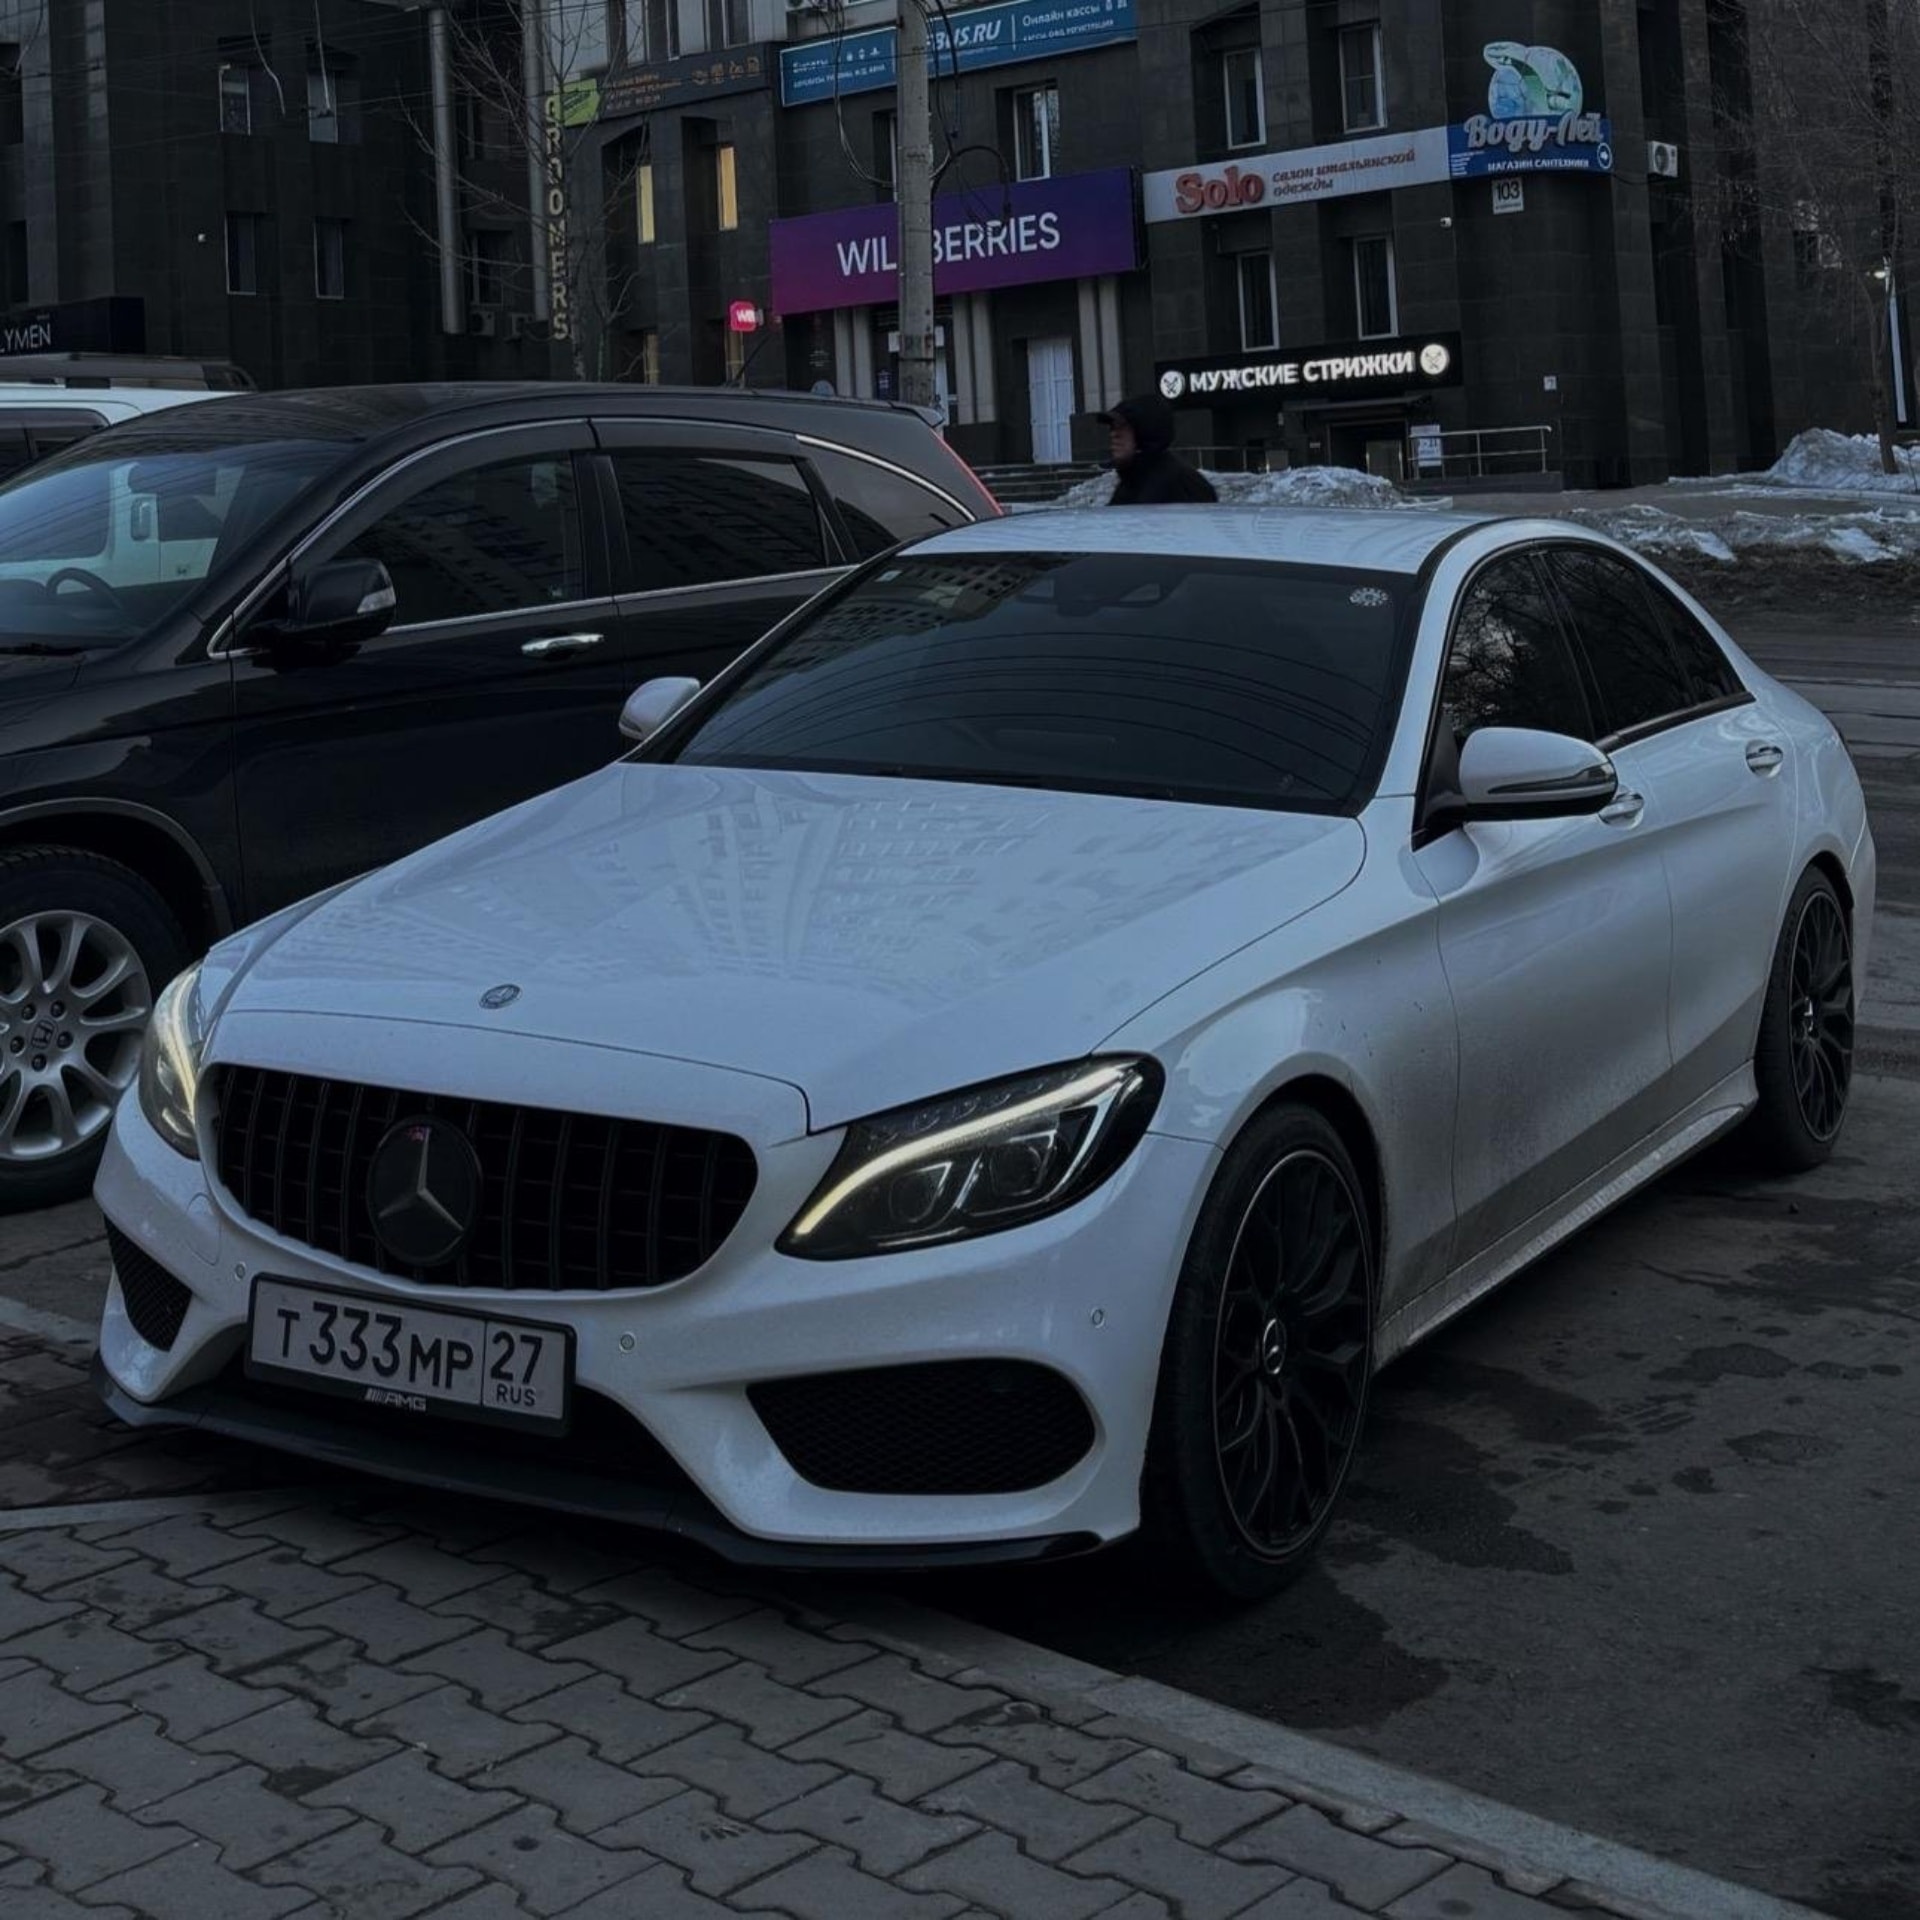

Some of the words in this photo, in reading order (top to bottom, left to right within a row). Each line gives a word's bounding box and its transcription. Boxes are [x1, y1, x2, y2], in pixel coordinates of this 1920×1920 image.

[1022, 10, 1064, 29] Онлайн
[1066, 5, 1102, 19] кассы
[1272, 167, 1314, 183] салон
[1316, 148, 1416, 176] итальянской
[1487, 159, 1534, 172] МАГАЗИН
[1175, 164, 1265, 214] Solo
[1273, 178, 1334, 198] одежды
[1497, 181, 1521, 201] 103
[836, 211, 1061, 277] WILBERRIES
[1189, 363, 1298, 393] МУЖСКИЕ
[1303, 350, 1414, 383] СТРИЖКИ
[490, 1331, 543, 1384] 27
[496, 1382, 537, 1407] RUS
